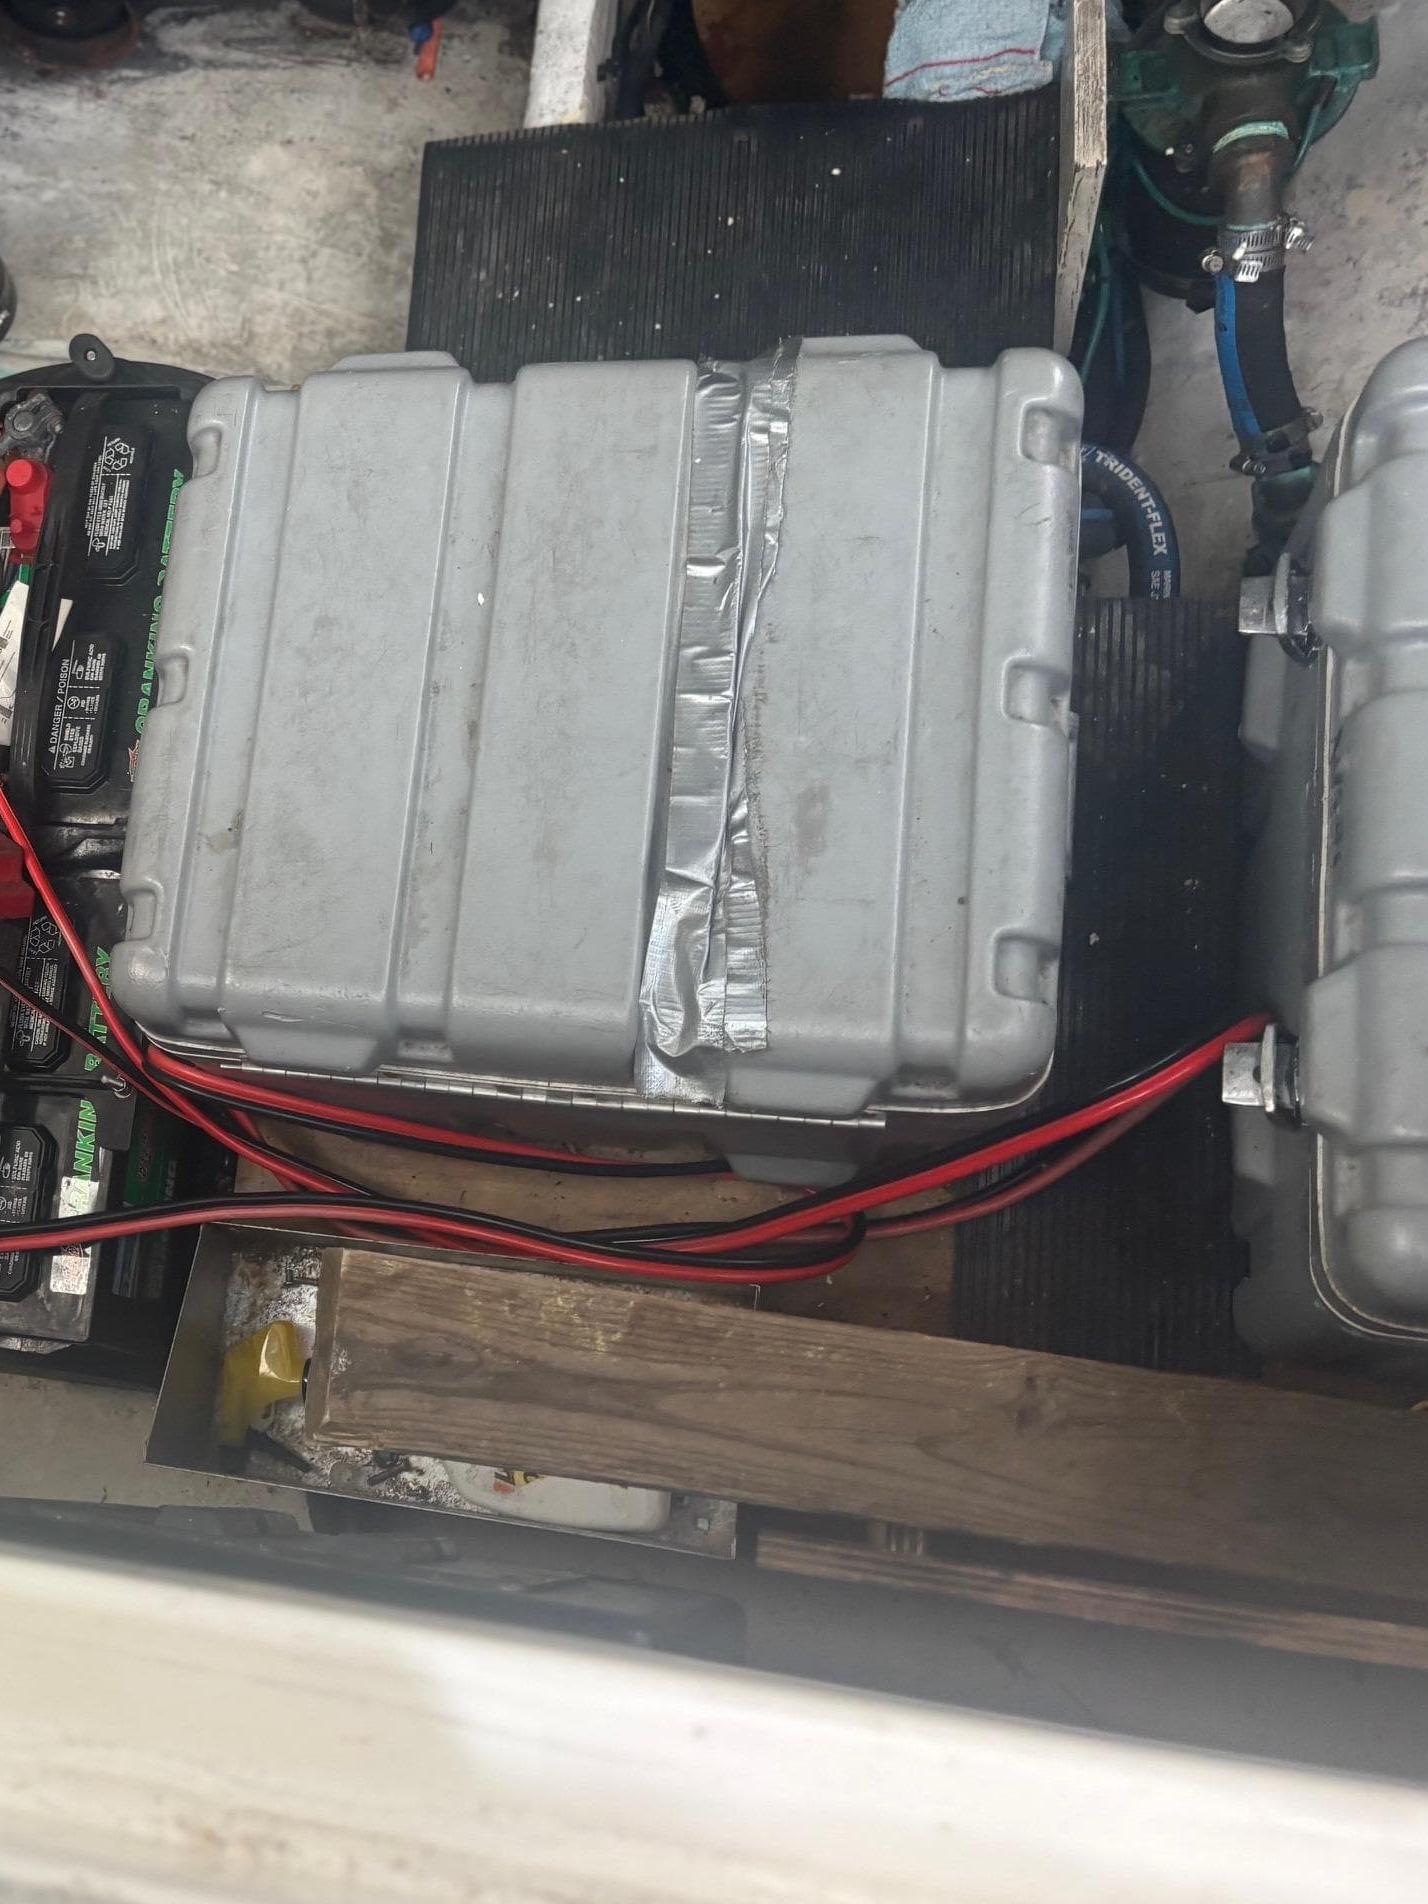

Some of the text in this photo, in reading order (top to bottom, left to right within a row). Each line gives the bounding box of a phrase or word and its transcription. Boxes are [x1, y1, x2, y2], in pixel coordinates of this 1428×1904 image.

[1095, 449, 1168, 556] TRIDENT-FLEX
[50, 705, 64, 743] DANGER
[58, 658, 72, 694] POISON
[71, 1099, 99, 1216] RANKIN
